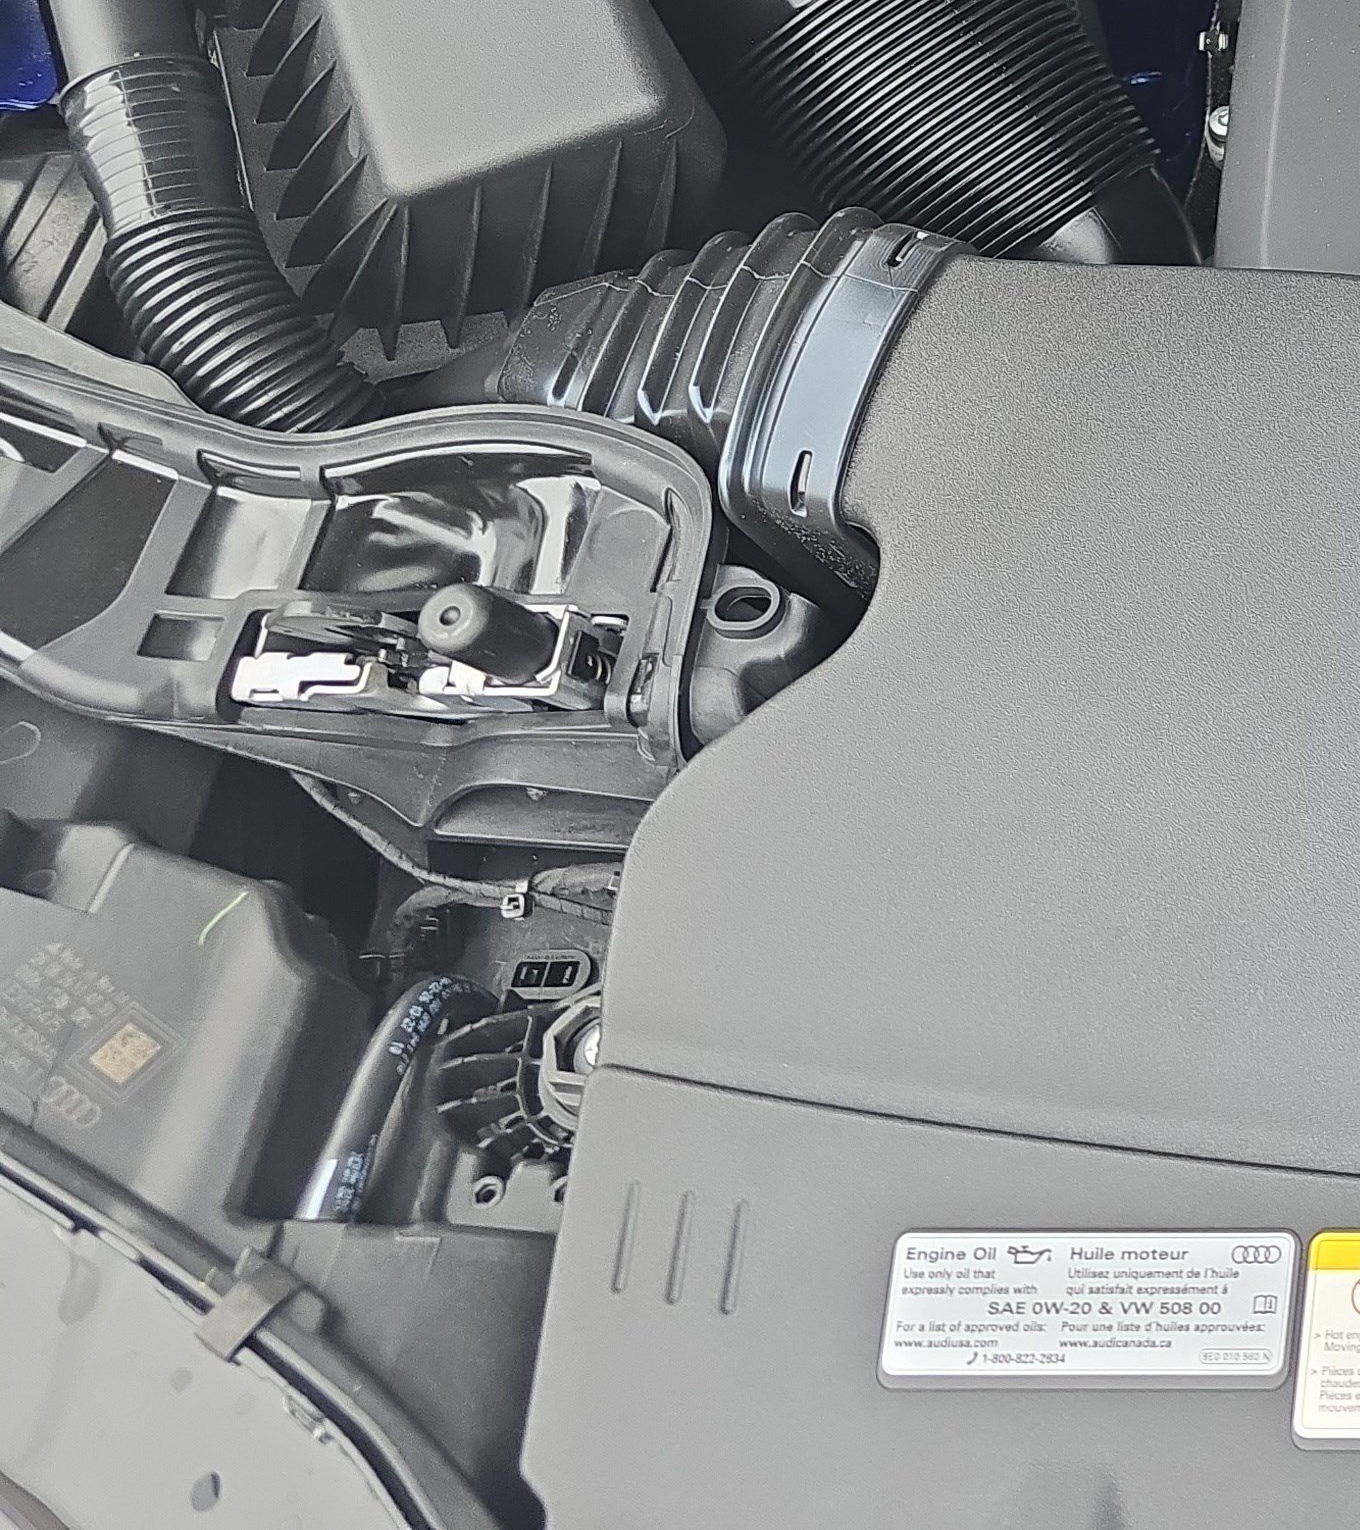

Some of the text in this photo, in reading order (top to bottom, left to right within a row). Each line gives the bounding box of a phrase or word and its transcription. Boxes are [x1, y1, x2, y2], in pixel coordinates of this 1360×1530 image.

[906, 1247, 997, 1262] Engine Oil
[1070, 1247, 1189, 1262] Huile moteur
[903, 1268, 995, 1282] Use only oil that
[1186, 1268, 1201, 1279] de
[958, 1284, 1010, 1296] complies
[1013, 1284, 1037, 1295] with
[1066, 1284, 1085, 1296] qui
[987, 1302, 1222, 1316] SAE 0W-20 & VW 508 00
[896, 1321, 916, 1333] For
[919, 1324, 925, 1333] a
[928, 1321, 946, 1333] list
[948, 1321, 961, 1333] of
[963, 1322, 1020, 1334] approved
[1061, 1321, 1088, 1333] Pour
[1090, 1324, 1112, 1333] une
[1117, 1321, 1141, 1333] liste
